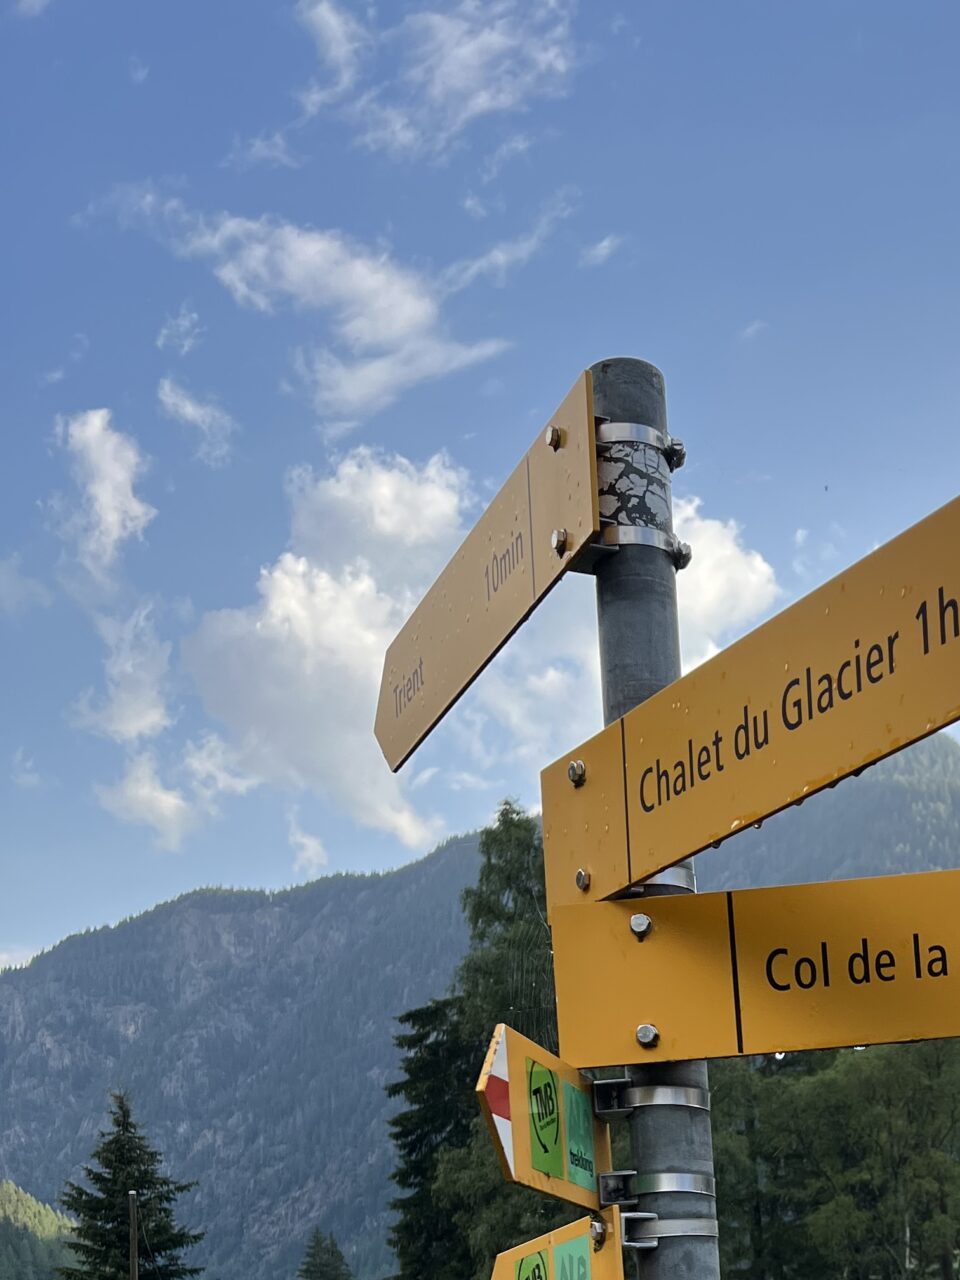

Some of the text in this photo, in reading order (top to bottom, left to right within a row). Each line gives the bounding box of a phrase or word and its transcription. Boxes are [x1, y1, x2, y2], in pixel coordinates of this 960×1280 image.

[483, 530, 525, 602] 10min
[392, 655, 426, 719] Trient
[639, 586, 960, 813] Chalet du Glacier 1h
[765, 941, 830, 992] Col
[847, 937, 896, 984] de
[913, 933, 949, 979] la
[532, 1081, 555, 1122] TMB
[569, 1147, 594, 1178] trekking
